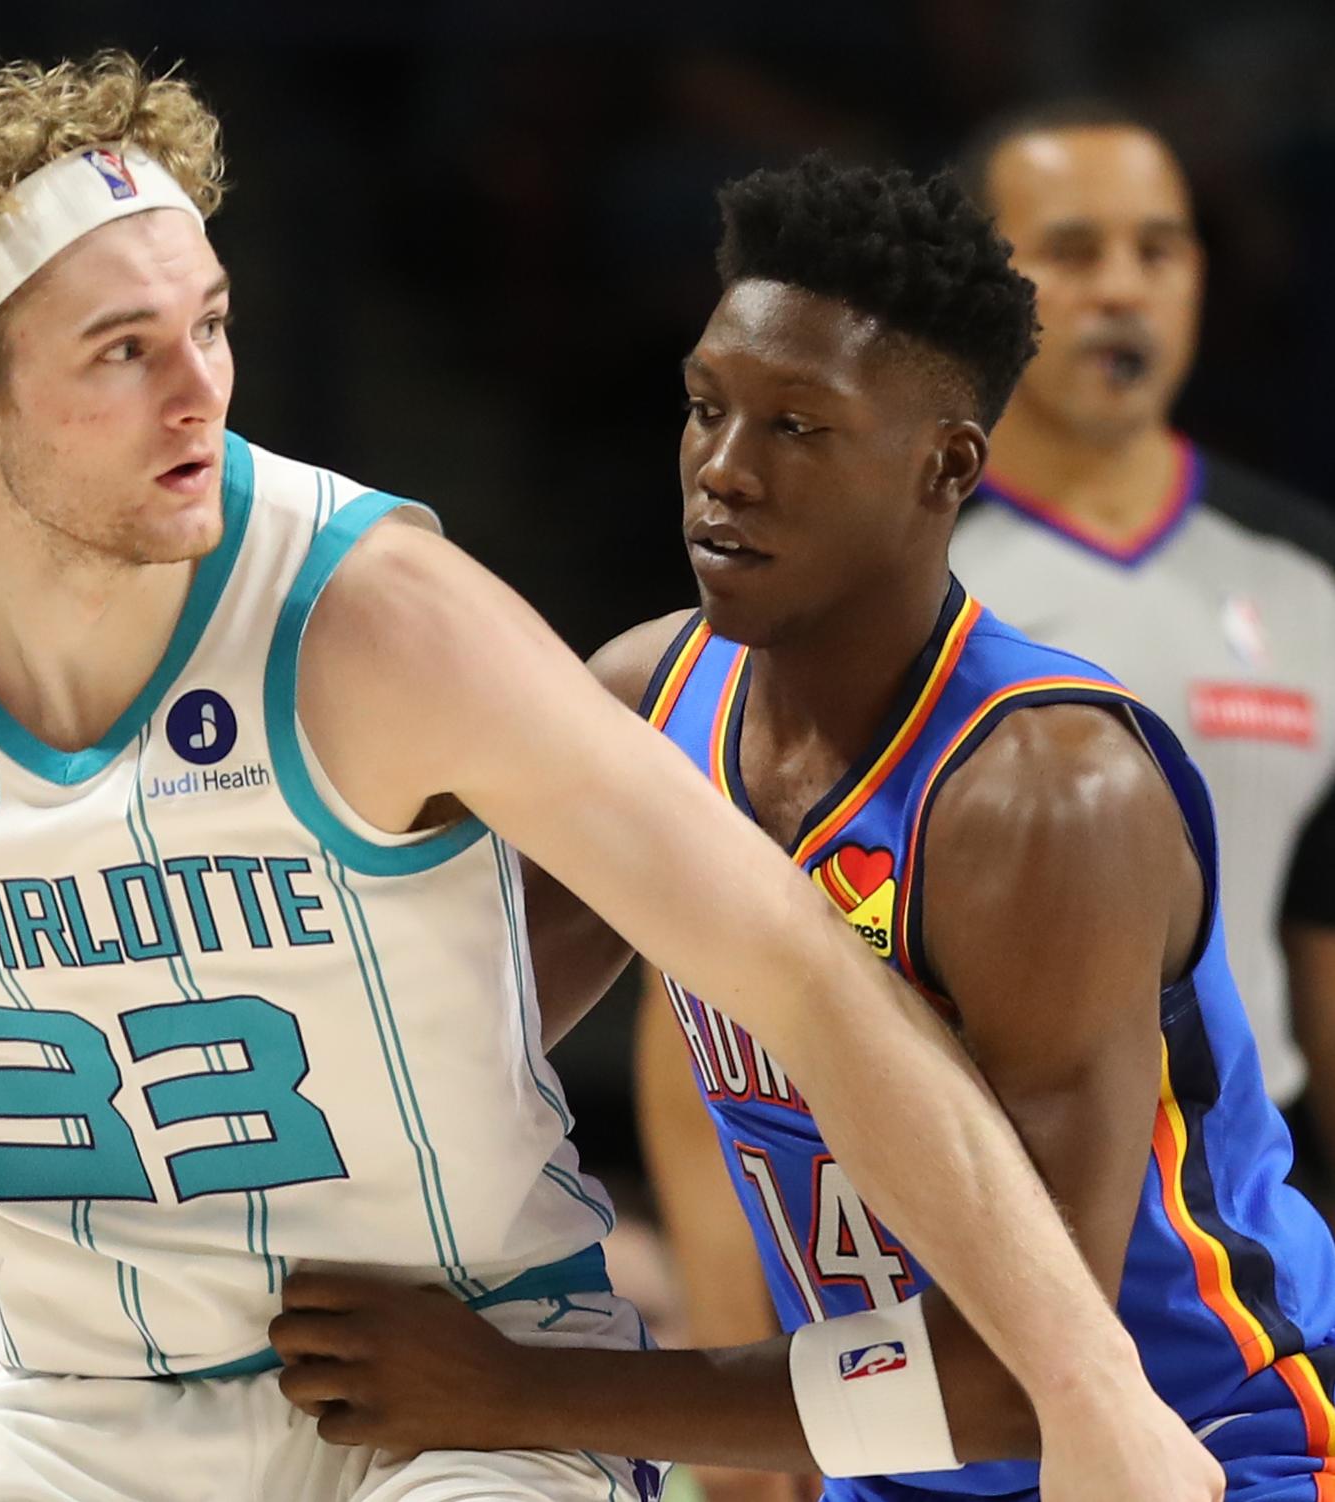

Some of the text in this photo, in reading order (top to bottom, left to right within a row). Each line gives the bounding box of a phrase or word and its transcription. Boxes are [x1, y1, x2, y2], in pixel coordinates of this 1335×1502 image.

[147, 763, 270, 799] Judi Health
[660, 970, 811, 1112] HUN
[734, 1140, 915, 1325] 14
